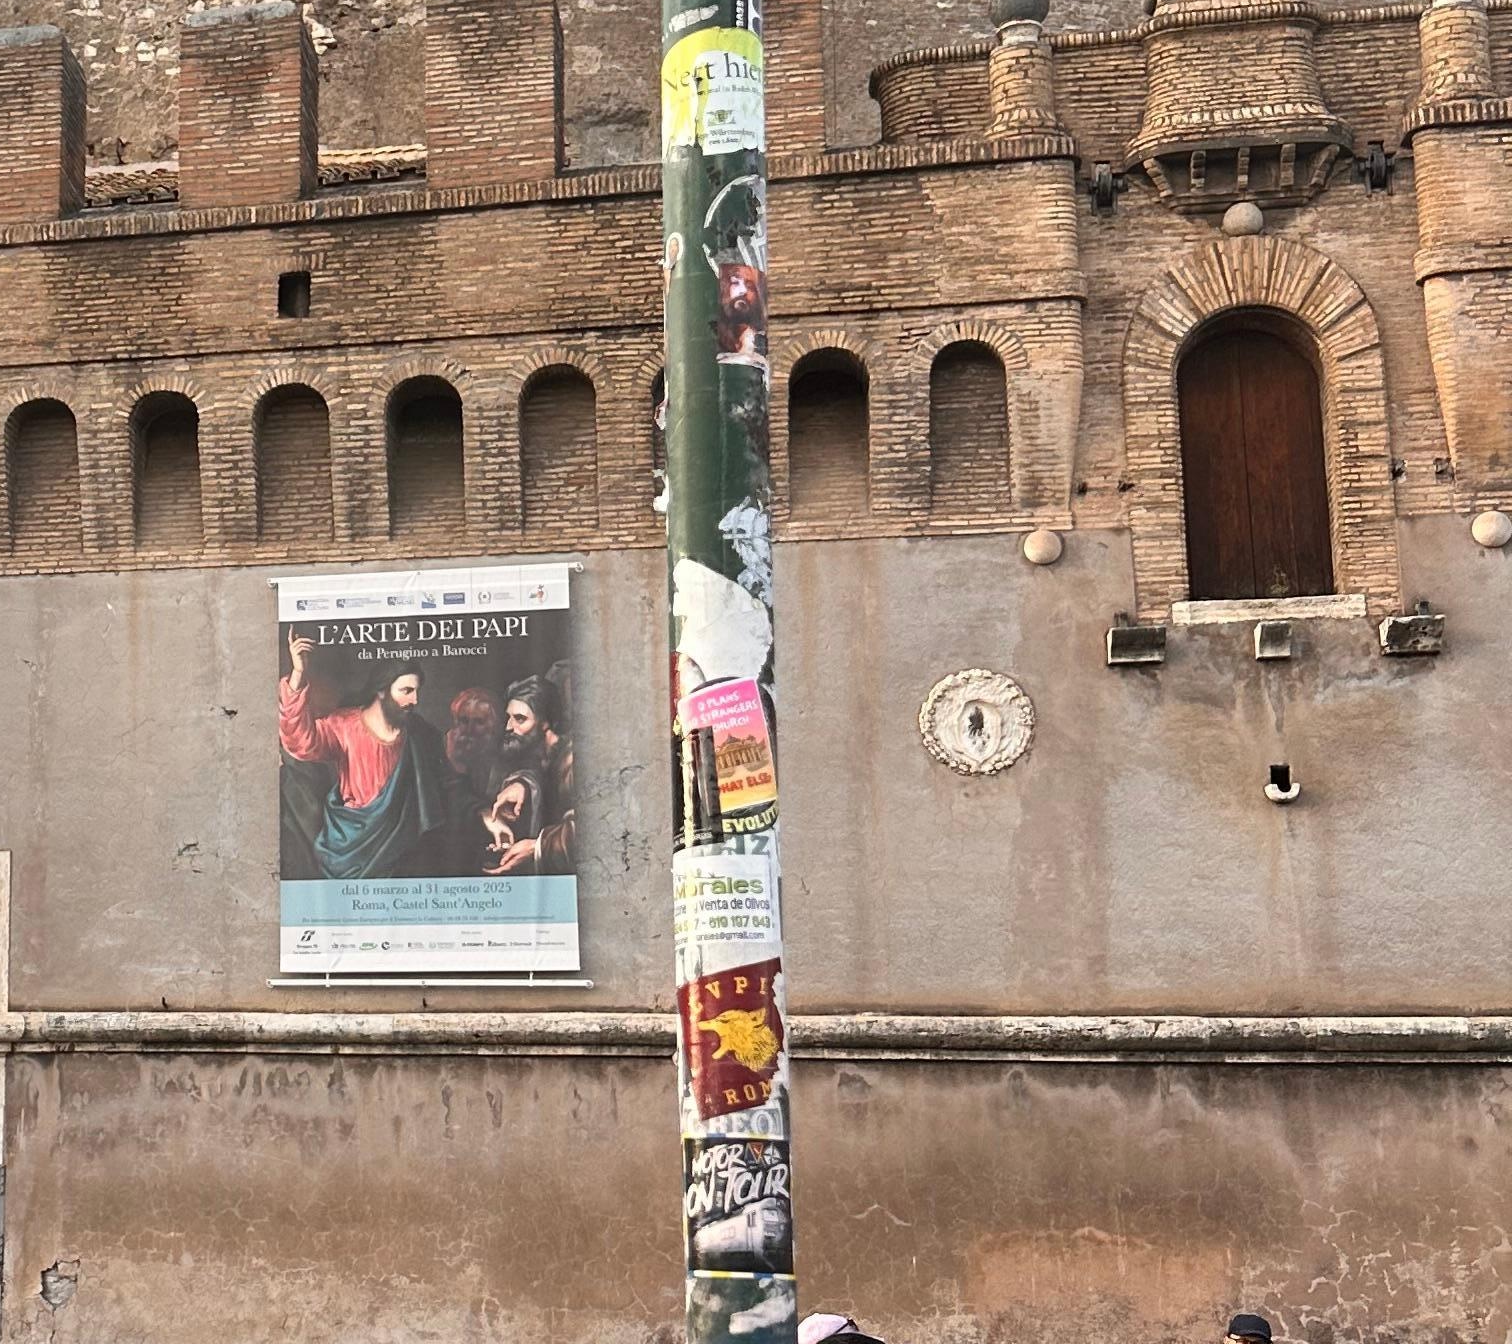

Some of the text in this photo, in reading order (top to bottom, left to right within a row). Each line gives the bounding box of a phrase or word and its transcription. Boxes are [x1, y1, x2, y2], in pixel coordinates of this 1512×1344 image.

[317, 615, 529, 645] L'ARTE DEI PAPI
[358, 642, 488, 662] da Perugino a Barocci
[699, 698, 758, 723] STRANGERS
[719, 779, 744, 794] HAT
[341, 882, 512, 897] dal 6 marzo al 31 agosto 2025
[352, 897, 503, 912] Roma, Castel Sant'Angelo
[729, 897, 743, 910] de
